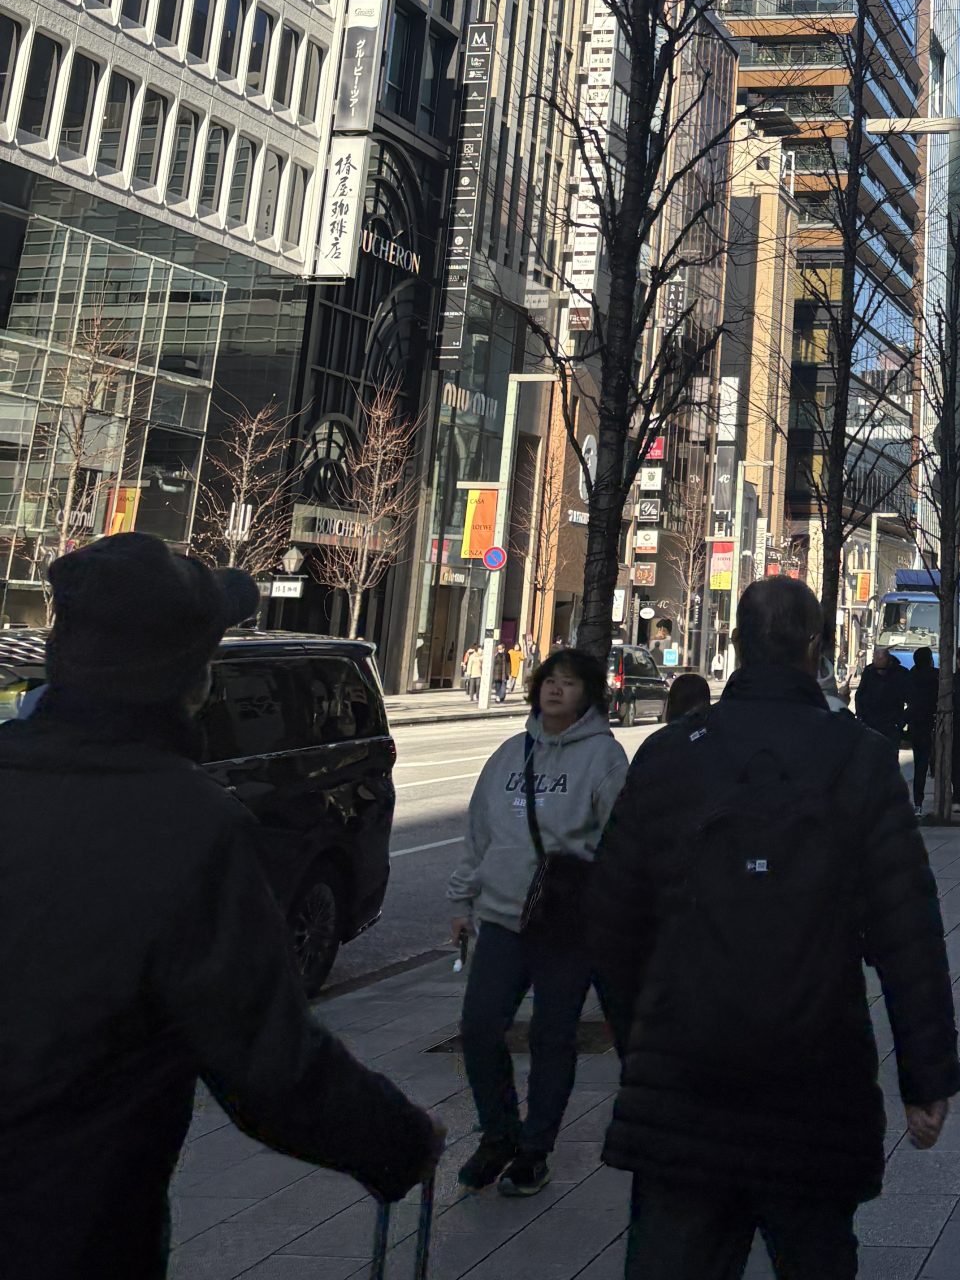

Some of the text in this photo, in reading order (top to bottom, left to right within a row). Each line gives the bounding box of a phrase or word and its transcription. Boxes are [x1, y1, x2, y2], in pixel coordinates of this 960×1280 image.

[325, 154, 357, 259] 椿屋珈琲店
[667, 284, 676, 325] SALON
[756, 527, 765, 550] JIMMY
